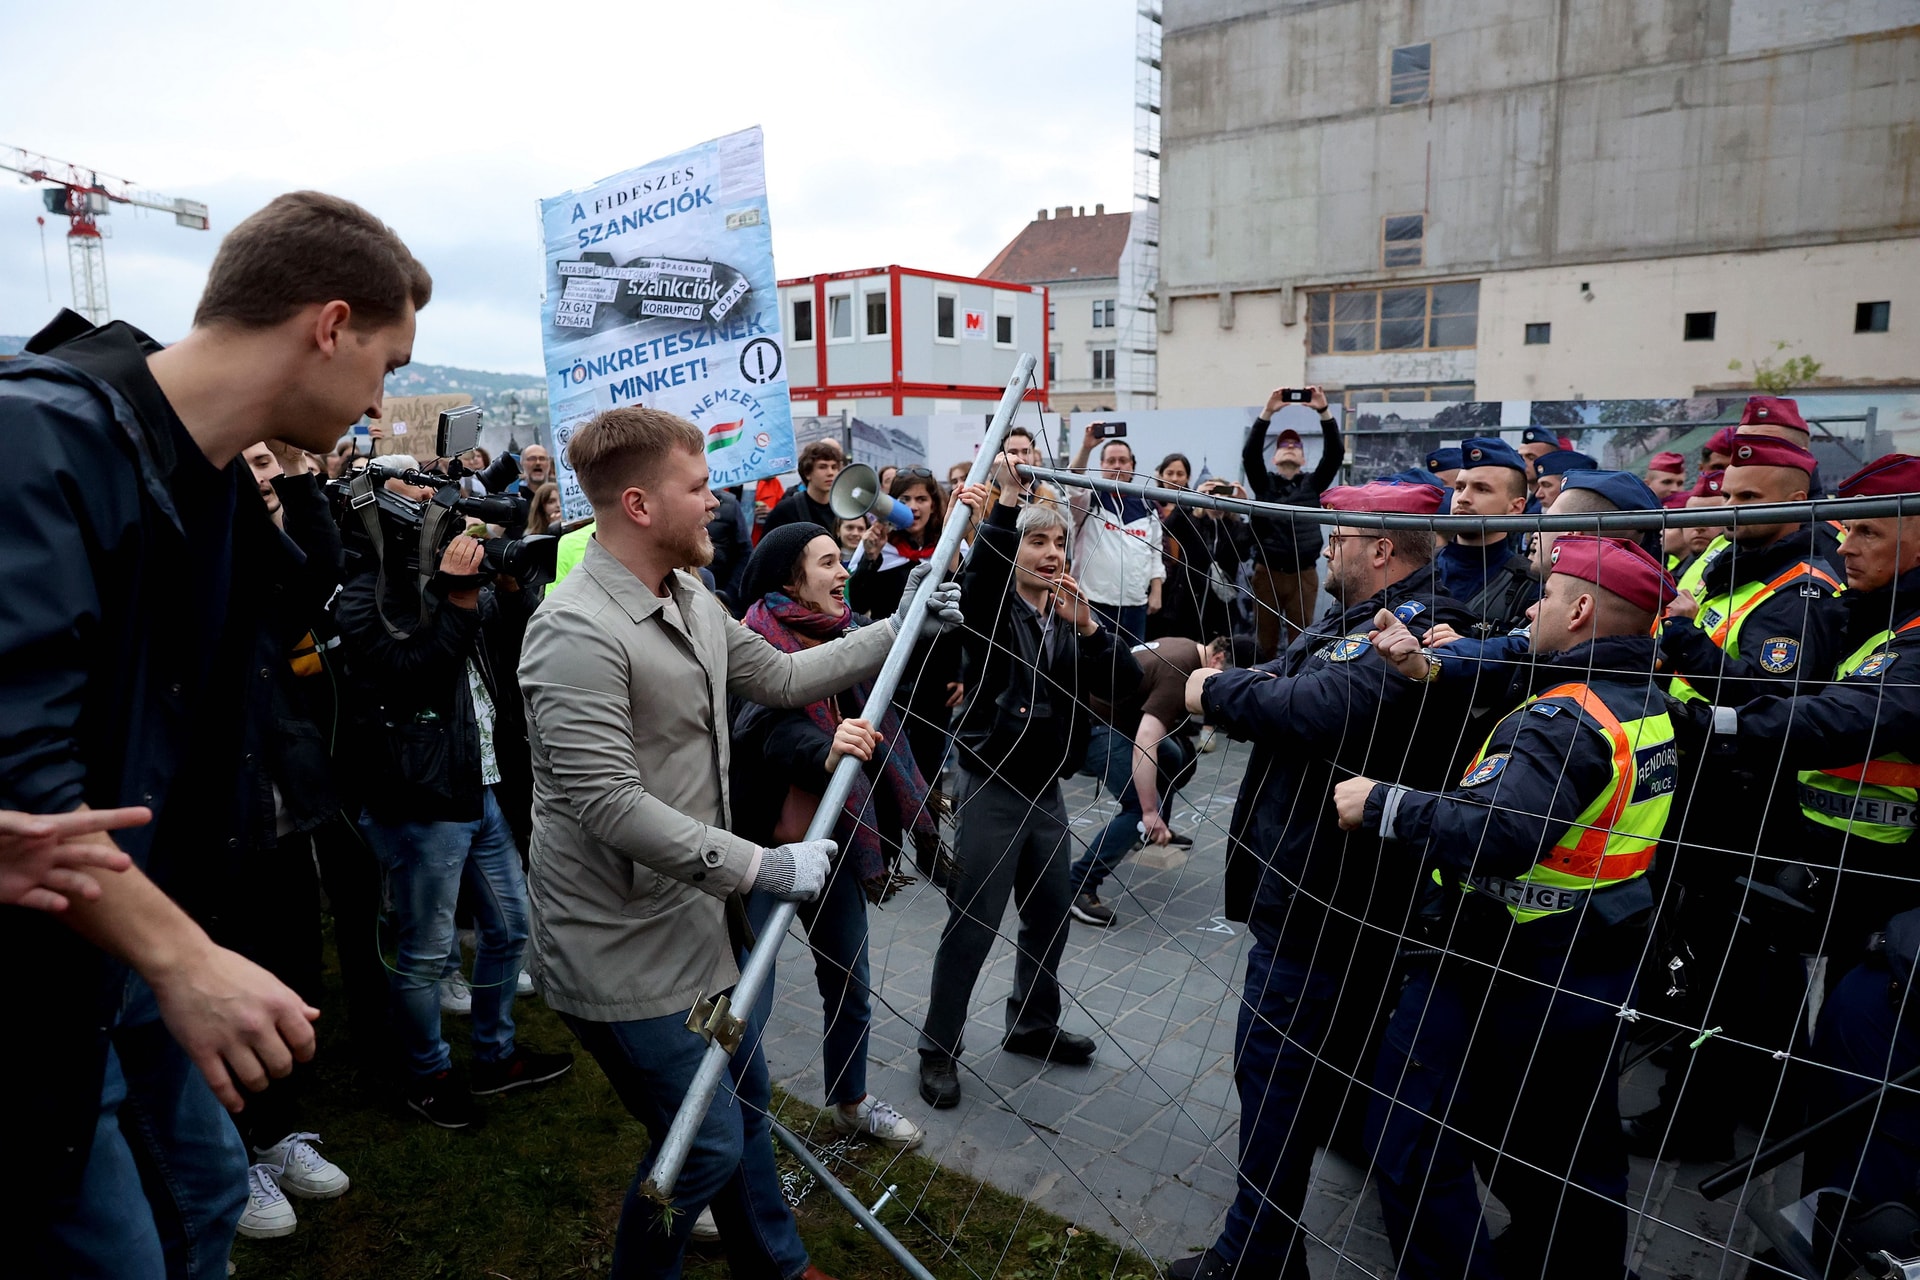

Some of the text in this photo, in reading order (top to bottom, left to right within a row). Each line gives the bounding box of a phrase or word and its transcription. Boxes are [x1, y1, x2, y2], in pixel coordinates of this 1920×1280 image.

[571, 166, 695, 225] A FIDESZES
[577, 184, 713, 249] SZANKCIÓK
[628, 277, 724, 301] szankciók
[712, 281, 747, 318] LOPÁS
[559, 300, 593, 314] 7X GÁZ
[642, 302, 701, 317] KORRUPCIÓ
[558, 311, 766, 389] TÖNKRETESZNEK
[609, 357, 708, 404] MINKET!
[690, 388, 765, 420] NEMZETI
[1807, 789, 1879, 819] POLICE
